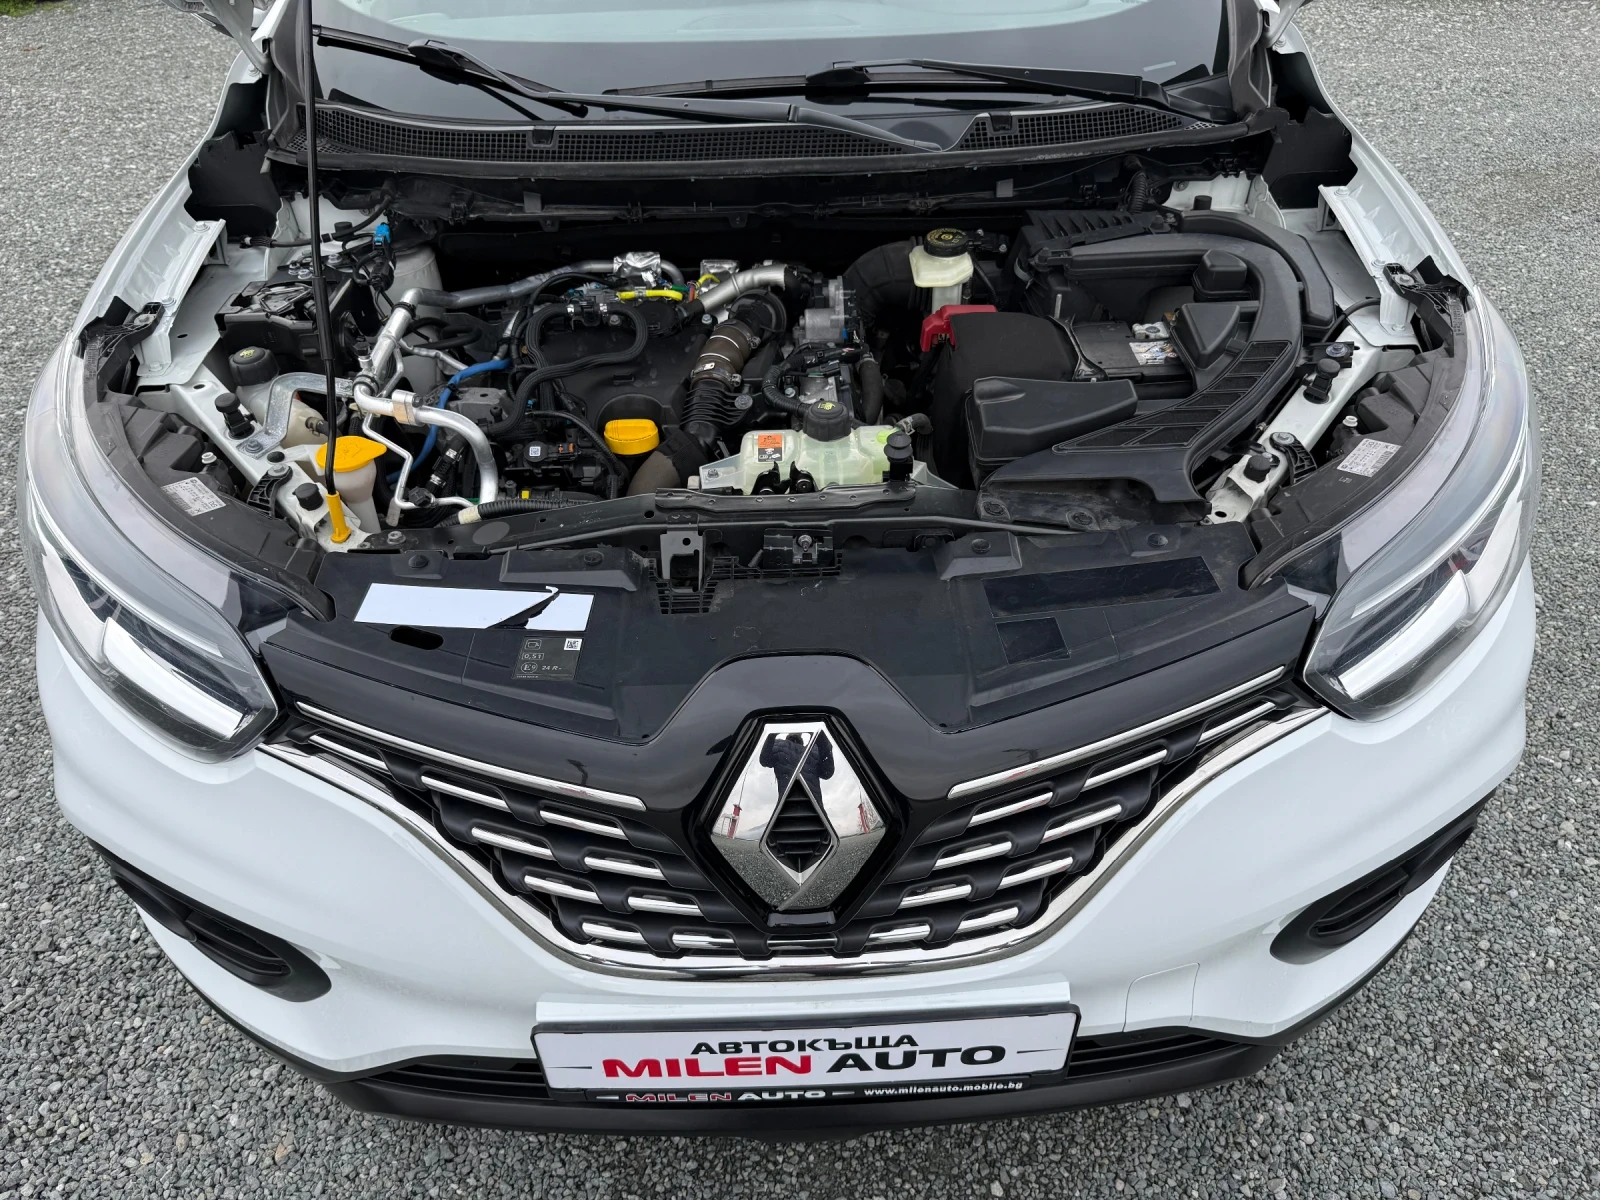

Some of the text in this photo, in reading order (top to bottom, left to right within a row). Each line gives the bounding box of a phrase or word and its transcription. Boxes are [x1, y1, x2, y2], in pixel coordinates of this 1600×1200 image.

[690, 1034, 920, 1055] АВТОКЪЩА
[602, 1045, 1006, 1078] MILEN AUTO
[625, 1090, 826, 1102] MILEN AUTO
[864, 1081, 1023, 1097] www.milenauto.mobile.bg
